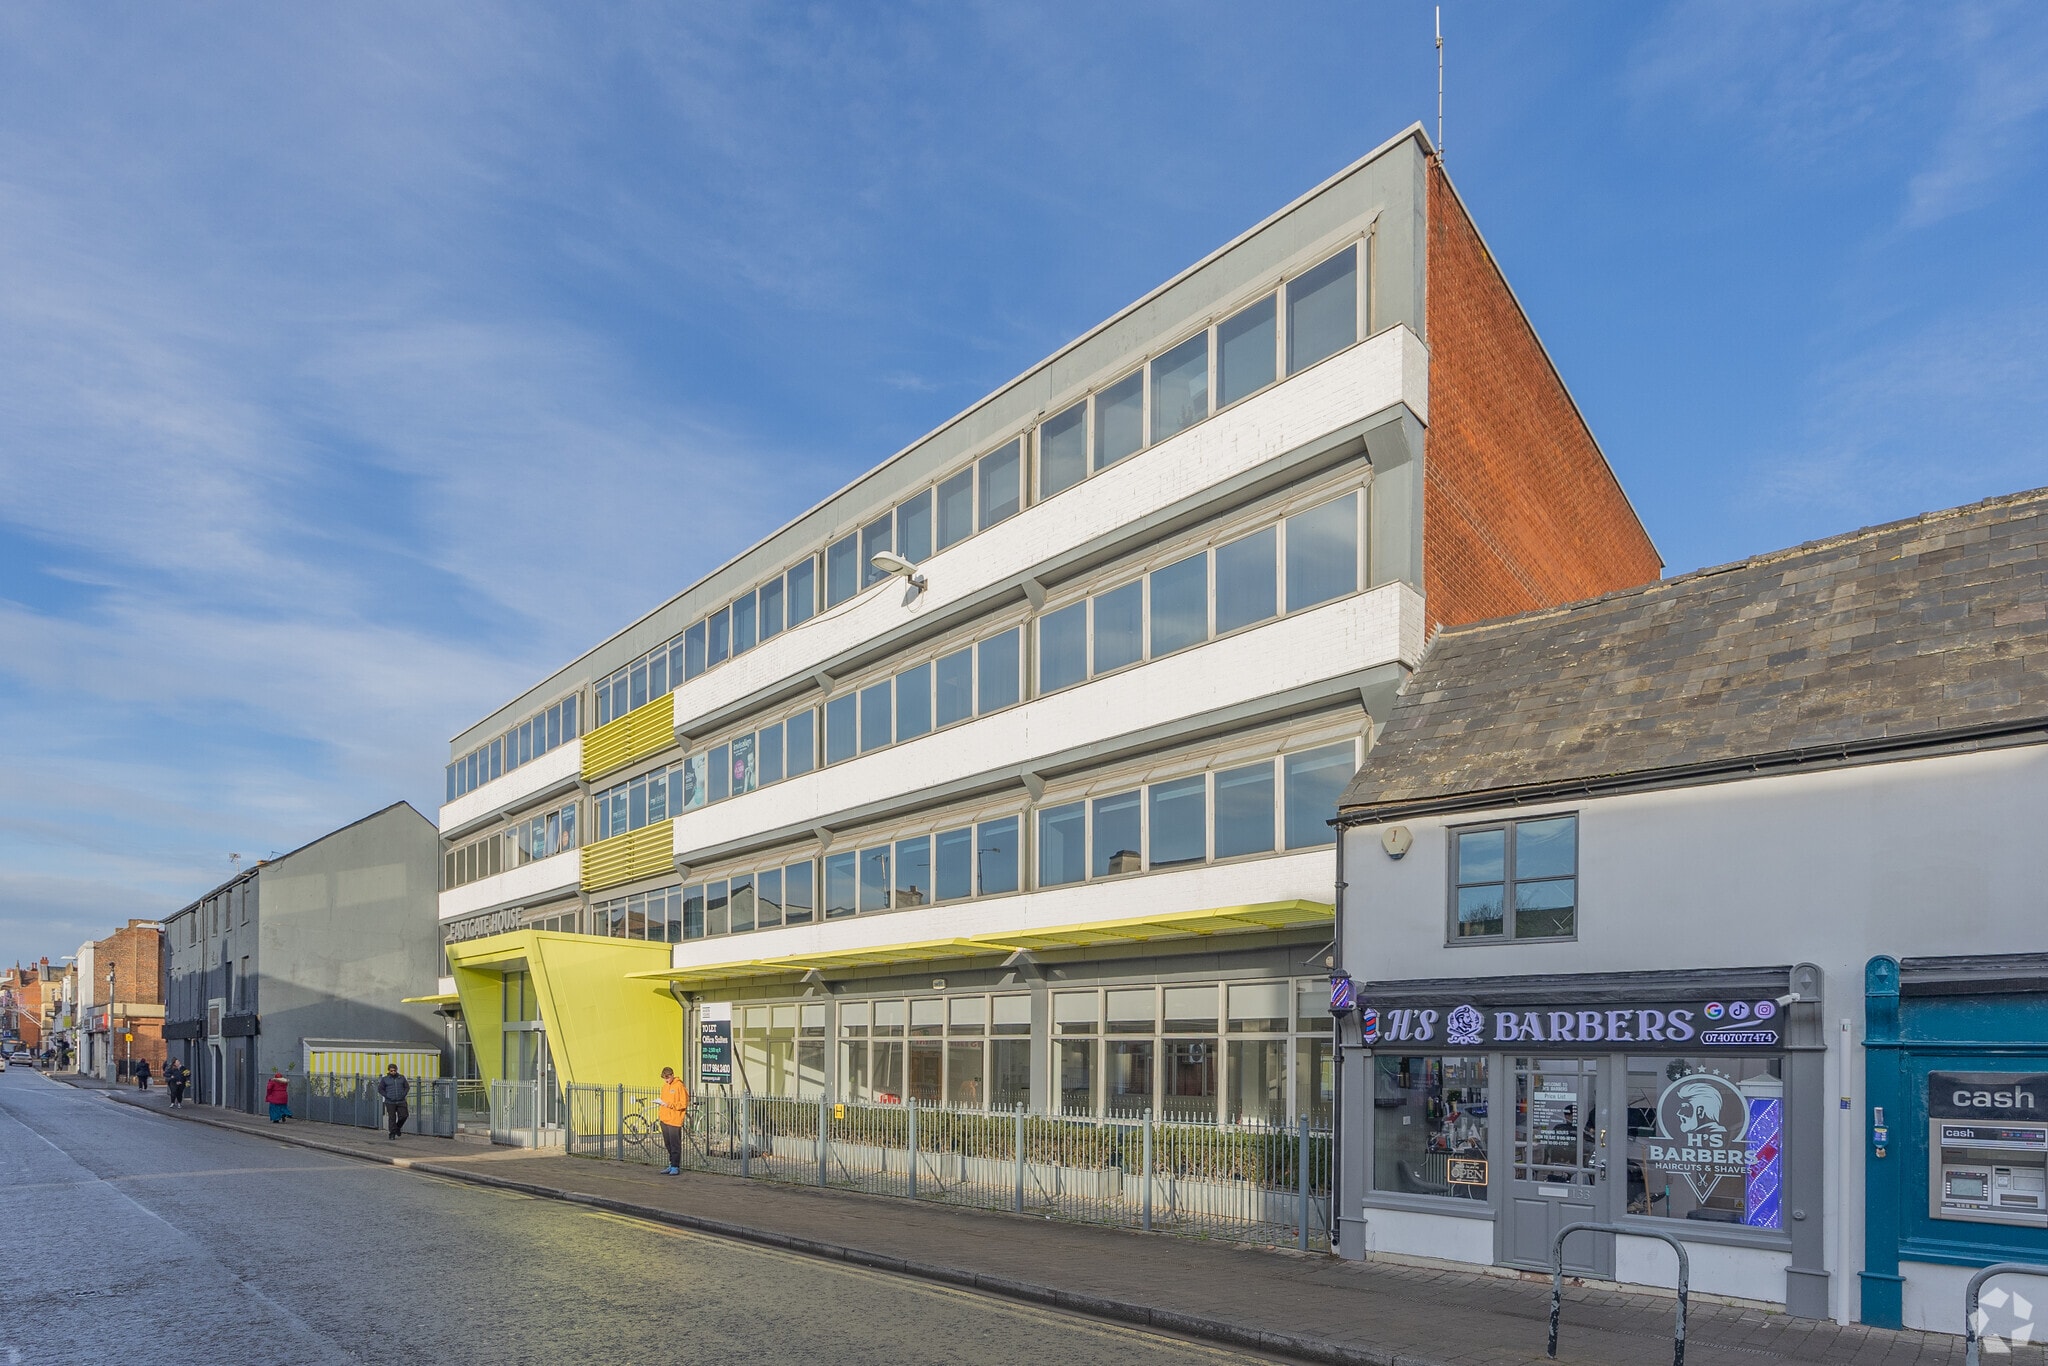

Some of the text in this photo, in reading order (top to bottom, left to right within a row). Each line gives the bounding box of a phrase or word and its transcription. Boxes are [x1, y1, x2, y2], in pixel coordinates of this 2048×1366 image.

[449, 906, 524, 940] EASTGATE HOUSE
[702, 1024, 717, 1032] TO LET
[1493, 1009, 1695, 1042] BARBERS
[702, 1035, 714, 1044] Office
[1705, 1033, 1772, 1042] 07407077474
[1953, 1085, 2035, 1108] cash
[1946, 1129, 1974, 1138] cash
[1687, 1133, 1724, 1148] H'S
[1649, 1145, 1758, 1165] BARBERS
[1451, 1167, 1485, 1180] OPEN
[1655, 1162, 1753, 1174] HAIRCUTS & SHAVES
[1572, 1188, 1592, 1200] 133
